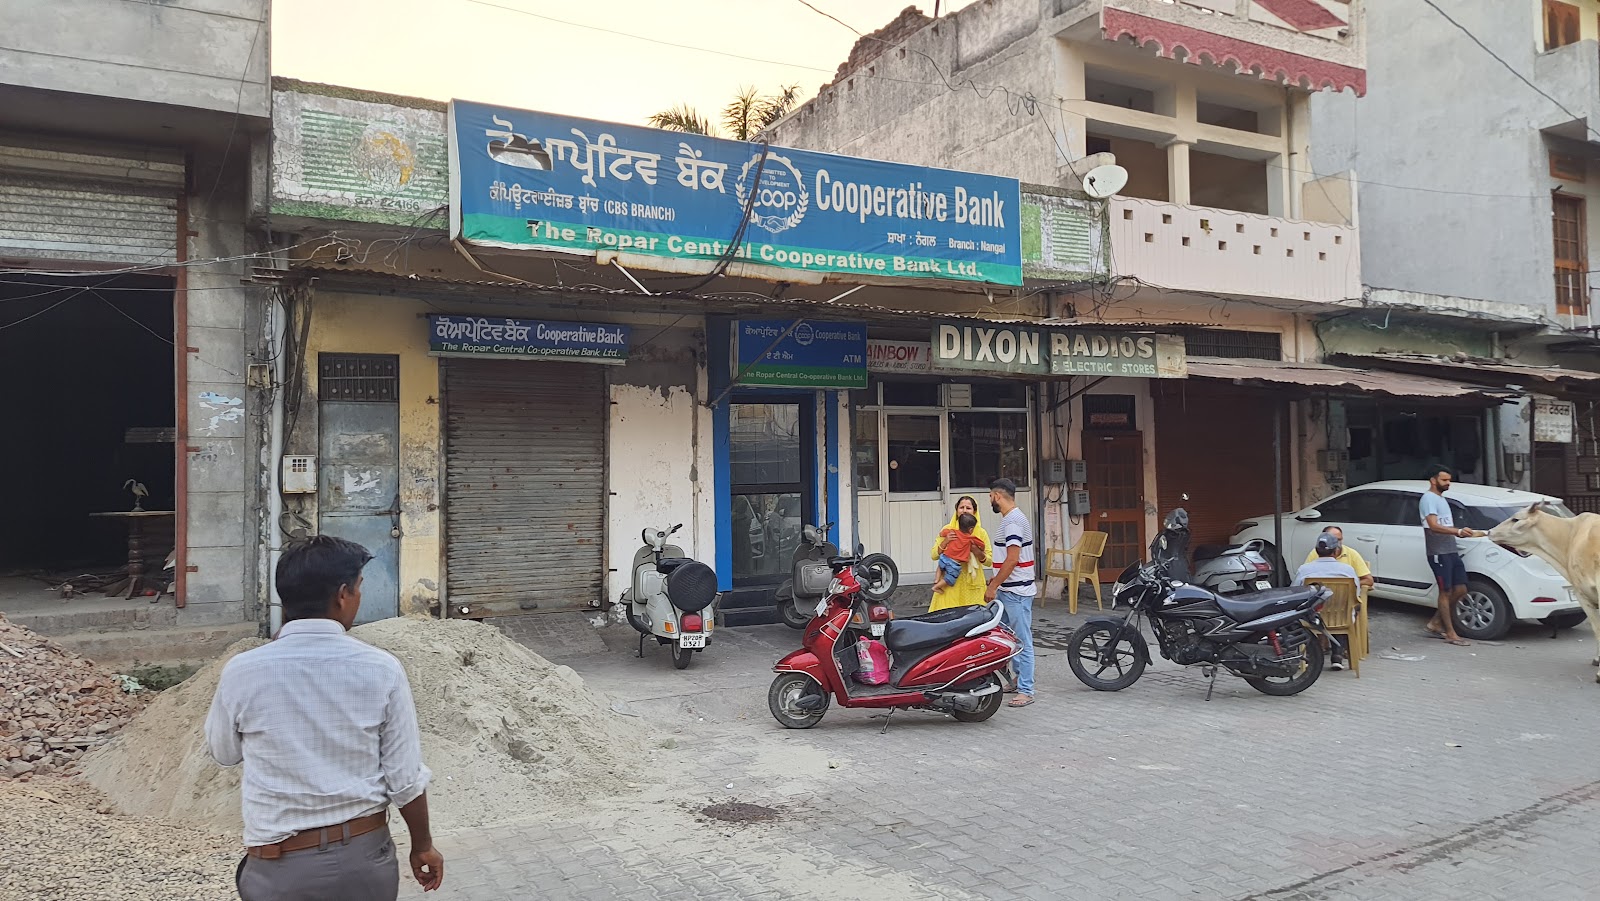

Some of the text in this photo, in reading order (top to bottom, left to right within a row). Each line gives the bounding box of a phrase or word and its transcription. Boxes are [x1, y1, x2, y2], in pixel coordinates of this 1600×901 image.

[675, 142, 728, 193] ਬੈਂਕ
[816, 169, 1005, 228] Cooperative Bank
[604, 200, 628, 216] (CBS
[631, 203, 676, 222] BRANCH)
[526, 219, 982, 276] The Ropar Central Cooperative Bank Ltd.
[948, 237, 974, 250] Branch
[980, 241, 1005, 255] Nangal
[504, 319, 531, 341] ਬੈਂਕ
[536, 323, 597, 345] Cooperative
[597, 327, 624, 344] Bank
[815, 329, 861, 341] Cooperative Bank
[441, 342, 621, 357] The Ropar Central Co-operative Bank Ltd.
[867, 344, 919, 361] AINBOW
[939, 324, 1039, 365] DIXON
[1051, 333, 1155, 359] RADIOS
[843, 355, 862, 363] ATM
[1064, 361, 1113, 373] ELECTRIC
[1121, 363, 1156, 375] STORES
[756, 371, 775, 380] Ropar
[799, 372, 836, 380] Co-operative
[853, 373, 864, 381] Ltd.
